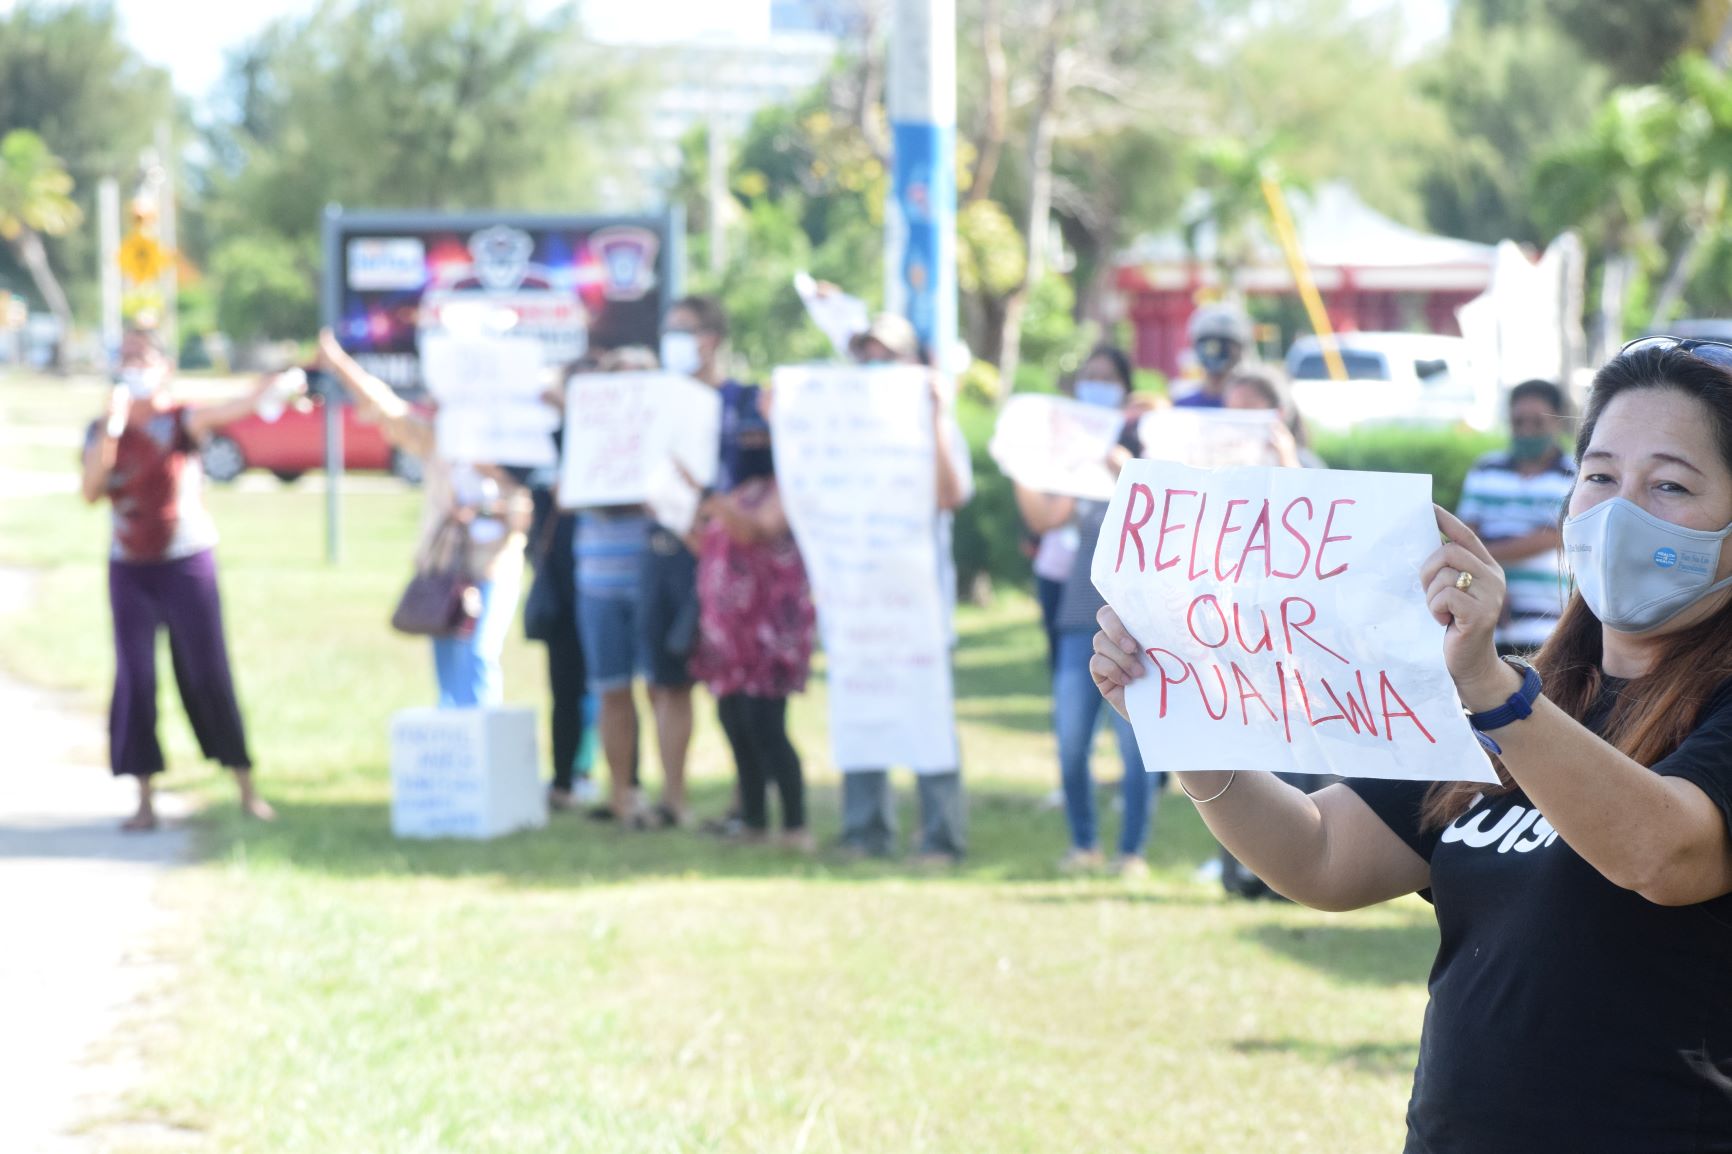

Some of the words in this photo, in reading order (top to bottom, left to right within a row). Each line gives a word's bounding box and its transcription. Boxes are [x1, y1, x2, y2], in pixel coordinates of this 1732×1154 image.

[1115, 482, 1357, 583] RELEASE
[1186, 594, 1350, 665] OUR
[1146, 647, 1437, 744] PUAILWA
